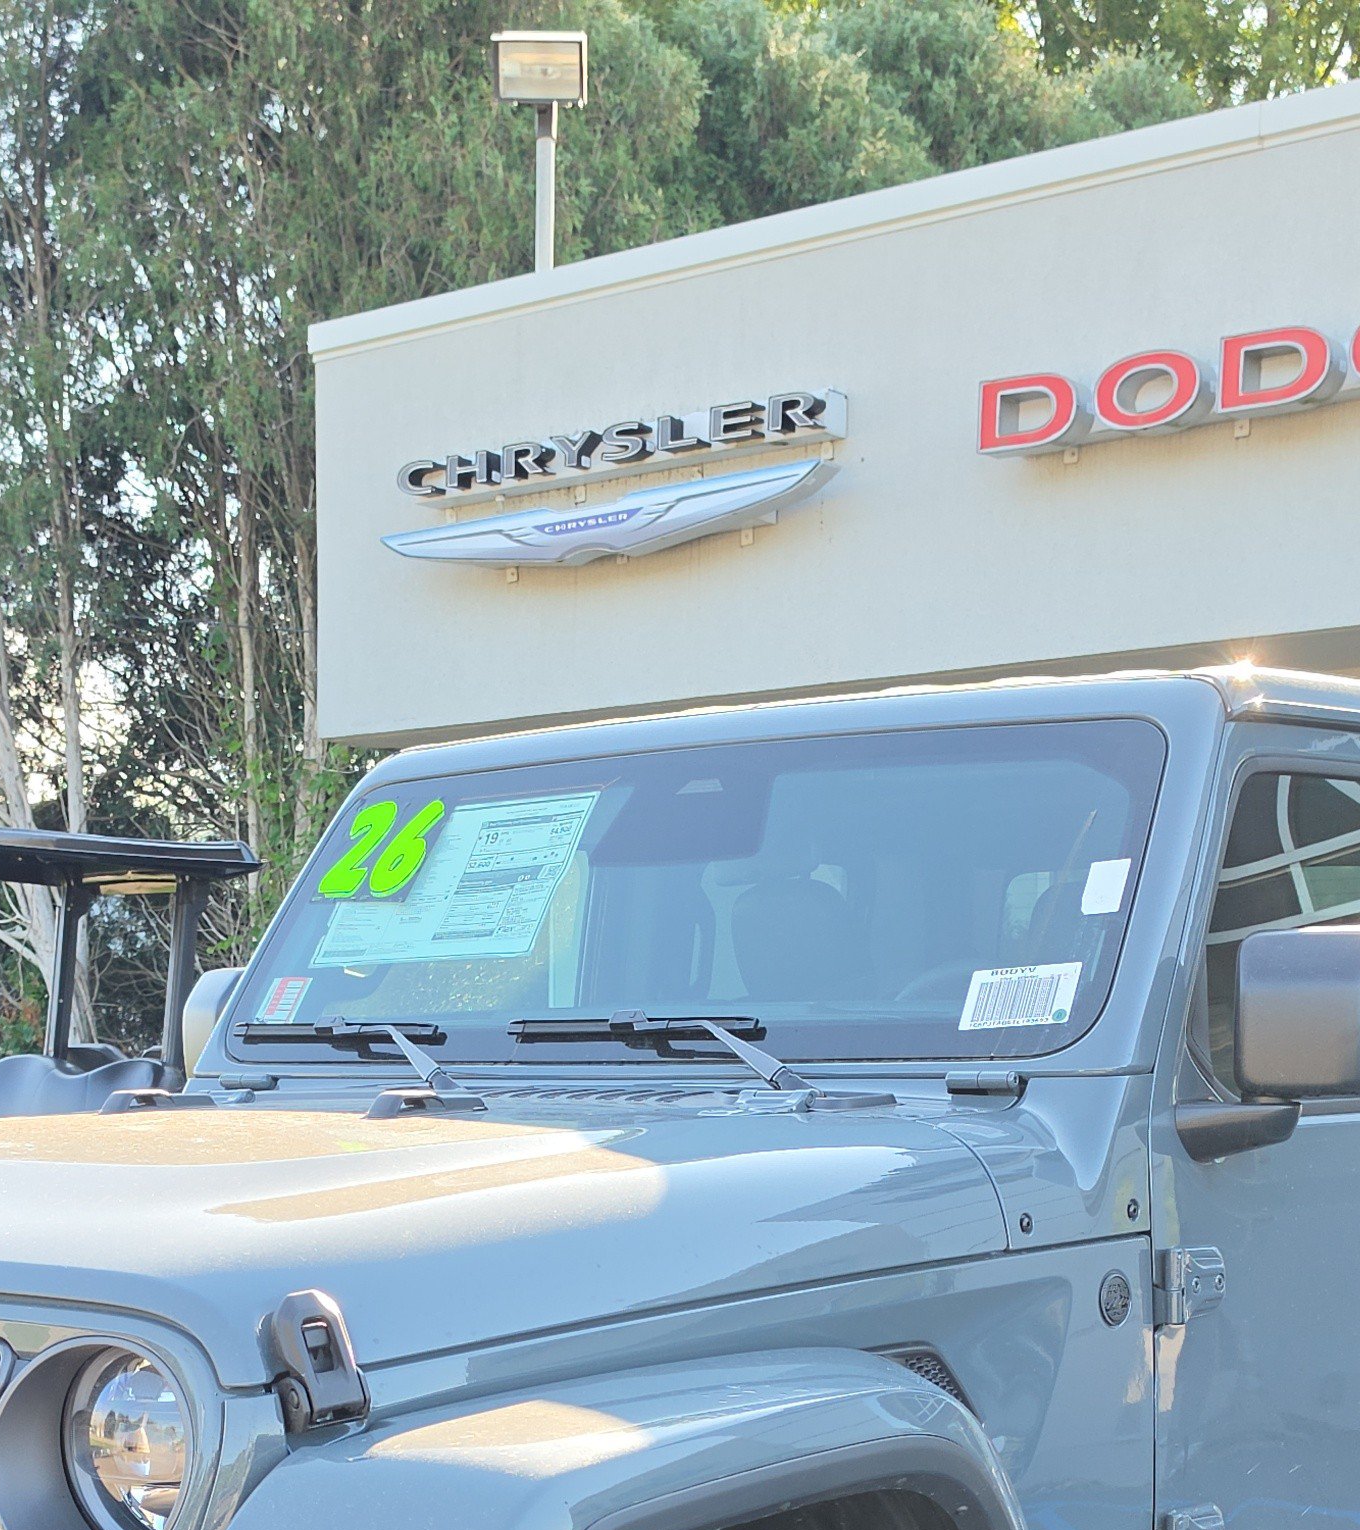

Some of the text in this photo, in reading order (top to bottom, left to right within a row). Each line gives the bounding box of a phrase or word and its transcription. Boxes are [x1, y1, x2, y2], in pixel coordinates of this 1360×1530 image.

[396, 392, 828, 497] CHRYSLER
[544, 513, 628, 533] CHRYSLER
[318, 800, 445, 898] 26
[484, 831, 500, 845] 19
